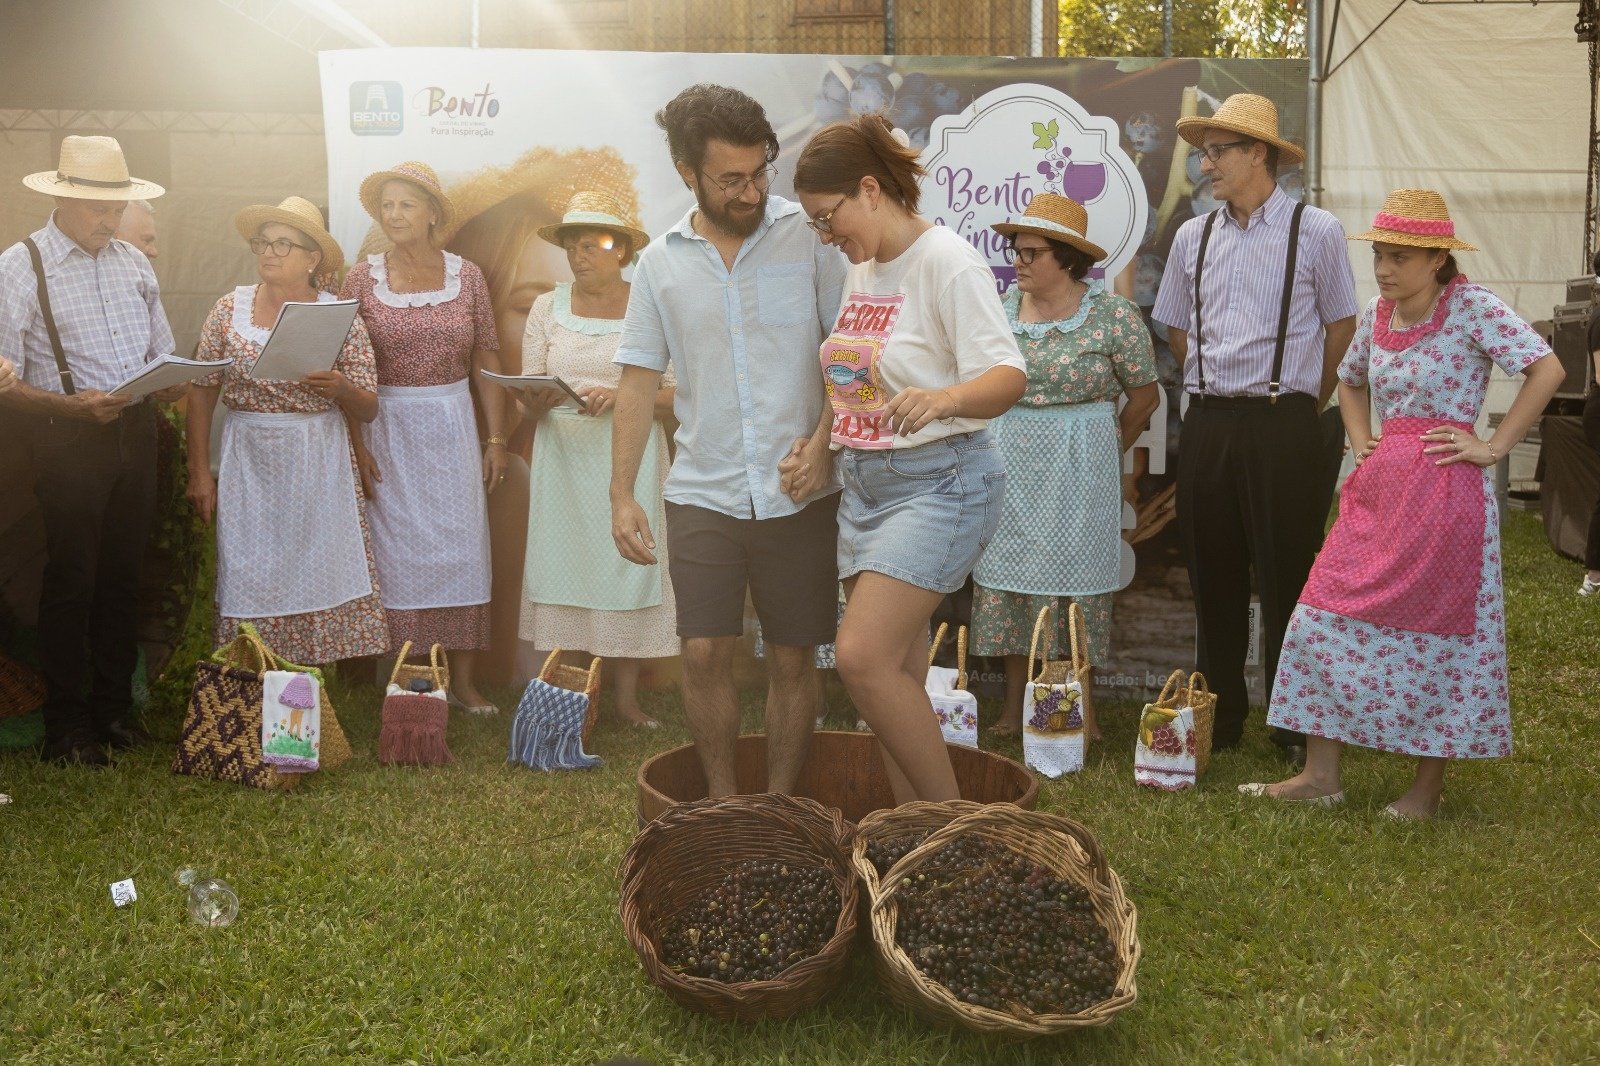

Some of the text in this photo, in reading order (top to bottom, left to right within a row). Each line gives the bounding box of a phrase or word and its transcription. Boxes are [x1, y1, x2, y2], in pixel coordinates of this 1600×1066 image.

[353, 111, 400, 121] BENTO
[431, 127, 494, 138] Pura Inspiração
[936, 165, 1034, 213] Bento
[837, 303, 895, 332] CAPRI
